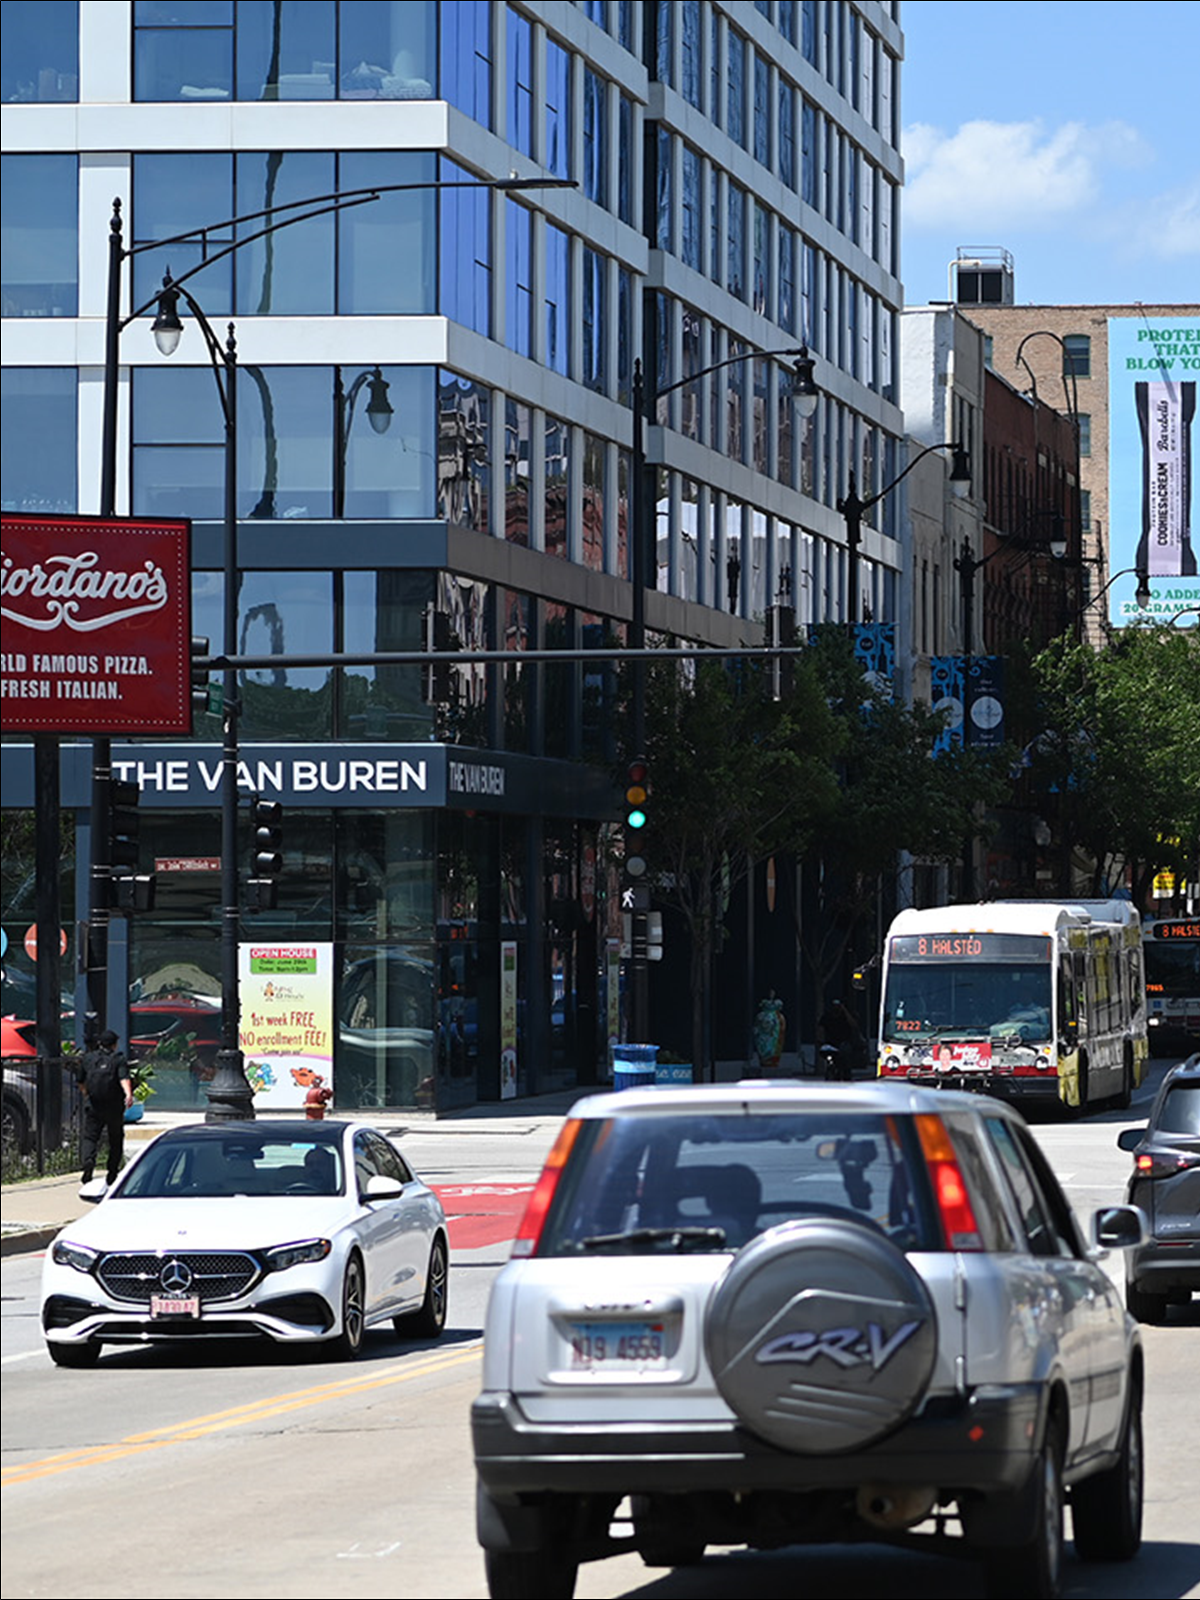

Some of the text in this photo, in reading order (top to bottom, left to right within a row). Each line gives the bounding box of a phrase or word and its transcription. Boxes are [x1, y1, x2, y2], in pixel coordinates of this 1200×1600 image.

[1155, 344, 1200, 355] THAT
[1126, 357, 1175, 370] BLOW
[2, 551, 168, 600] iordano's
[1124, 604, 1139, 613] 20
[1144, 603, 1190, 613] GRAMS
[33, 654, 99, 674] FAMOUS
[105, 656, 153, 675] PIZZA.
[2, 679, 123, 700] FRESH ITALIAN.
[112, 761, 427, 791] THE VAN BUREN
[449, 761, 505, 795] THE VAN BUREN
[1162, 925, 1169, 937] 8
[252, 949, 314, 958] OPEN HOUSE
[918, 938, 982, 955] 8 HALSTED
[267, 1012, 287, 1026] week
[290, 1011, 317, 1029] FREE,
[240, 1030, 327, 1047] NO enrollment FEE!
[755, 1321, 926, 1371] CR-V
